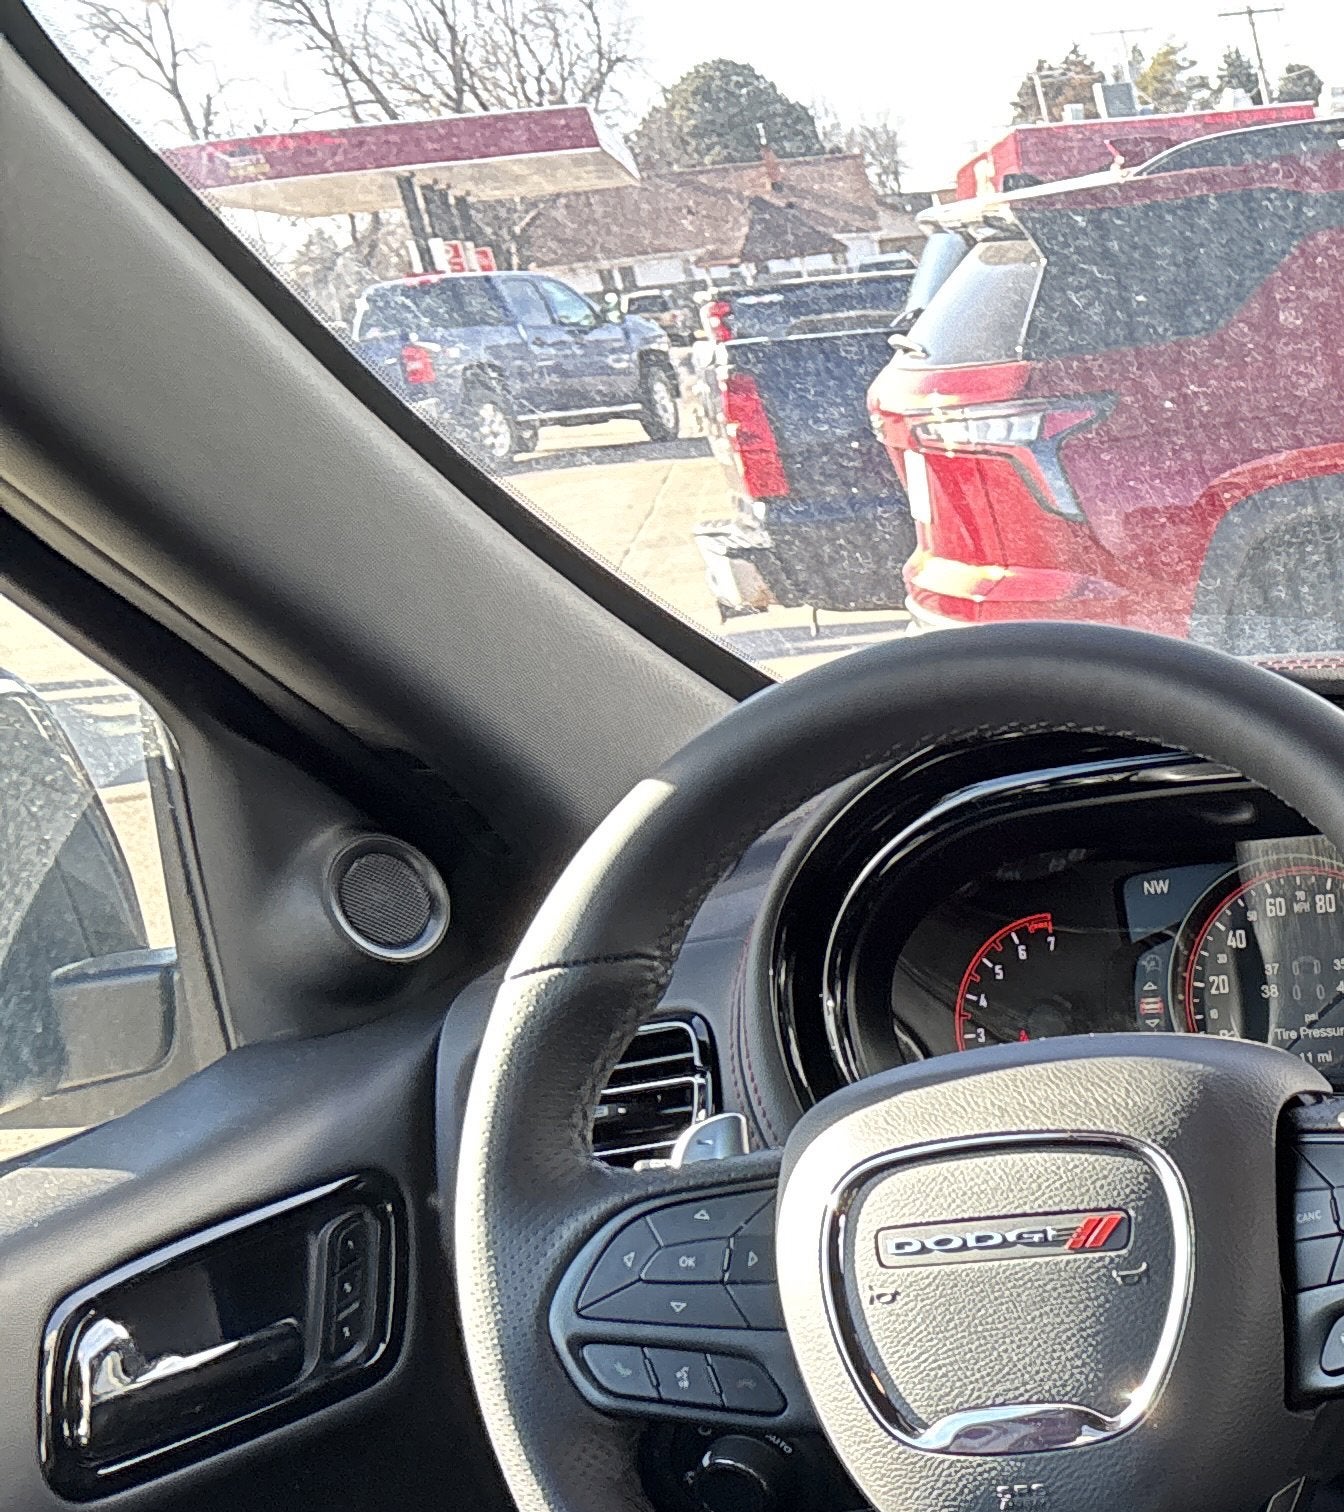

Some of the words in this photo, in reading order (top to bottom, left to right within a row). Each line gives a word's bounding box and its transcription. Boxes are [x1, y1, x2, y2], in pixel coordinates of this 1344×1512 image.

[1143, 879, 1170, 895] NW
[1266, 897, 1287, 918] 60
[1315, 893, 1336, 914] 80
[1046, 935, 1056, 952] 7
[1226, 929, 1247, 949] 40
[1017, 944, 1028, 960] 6
[994, 964, 1004, 980] 5
[1264, 963, 1280, 976] 37
[1208, 974, 1230, 995] 20
[1260, 984, 1280, 998] 38
[978, 993, 988, 1008] 4
[976, 1027, 986, 1043] 3
[1274, 1028, 1298, 1040] Tire
[1317, 1051, 1333, 1063] mi
[1296, 1209, 1322, 1224] CANC
[678, 1255, 696, 1267] OK
